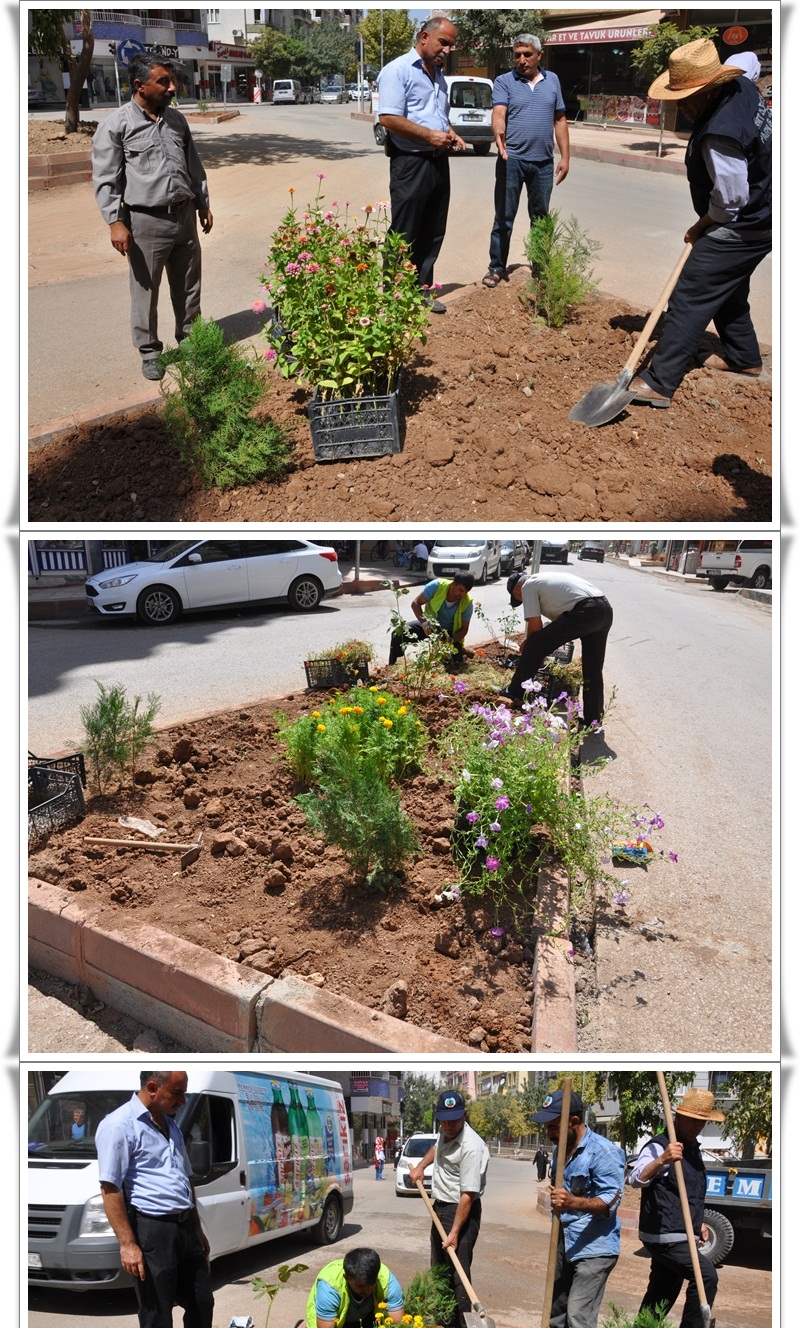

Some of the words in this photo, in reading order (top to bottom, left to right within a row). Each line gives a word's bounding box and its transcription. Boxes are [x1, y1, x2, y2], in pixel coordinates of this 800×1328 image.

[558, 33, 566, 41] ET
[568, 33, 578, 41] VE
[580, 30, 606, 40] TAVUK
